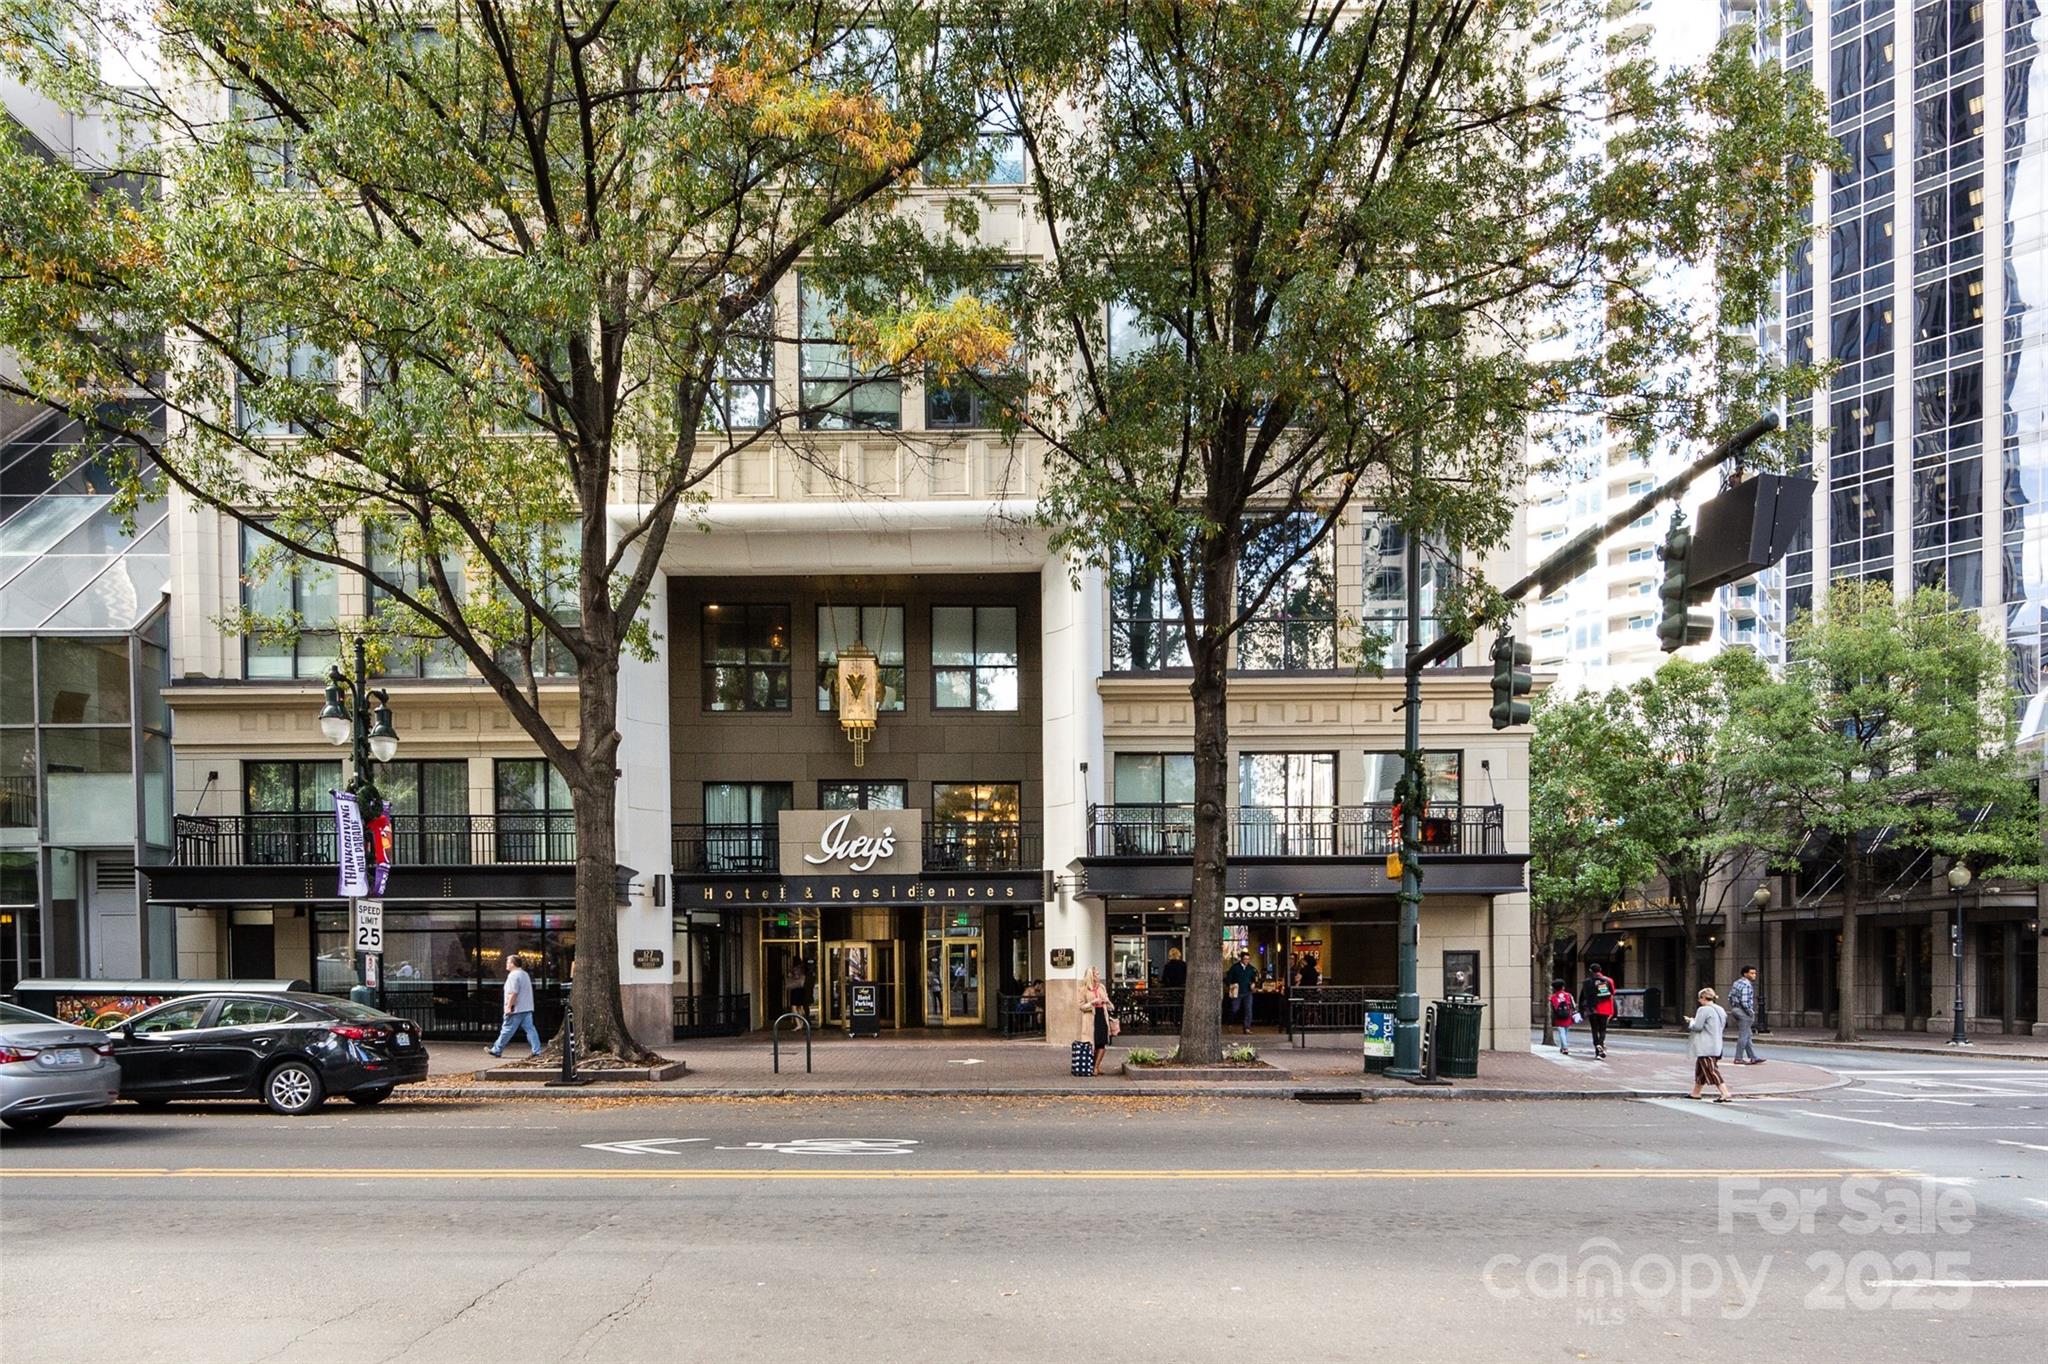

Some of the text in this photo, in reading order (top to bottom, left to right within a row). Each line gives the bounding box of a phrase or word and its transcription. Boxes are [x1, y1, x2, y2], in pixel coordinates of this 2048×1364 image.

[803, 813, 896, 872] Ivey's
[704, 885, 1014, 900] Hotel & Residences
[358, 905, 381, 916] SPEED
[1223, 896, 1298, 912] DOBA
[360, 916, 379, 926] LIMIT
[358, 926, 381, 947] 25
[1383, 1013, 1392, 1056] RECYCLE
